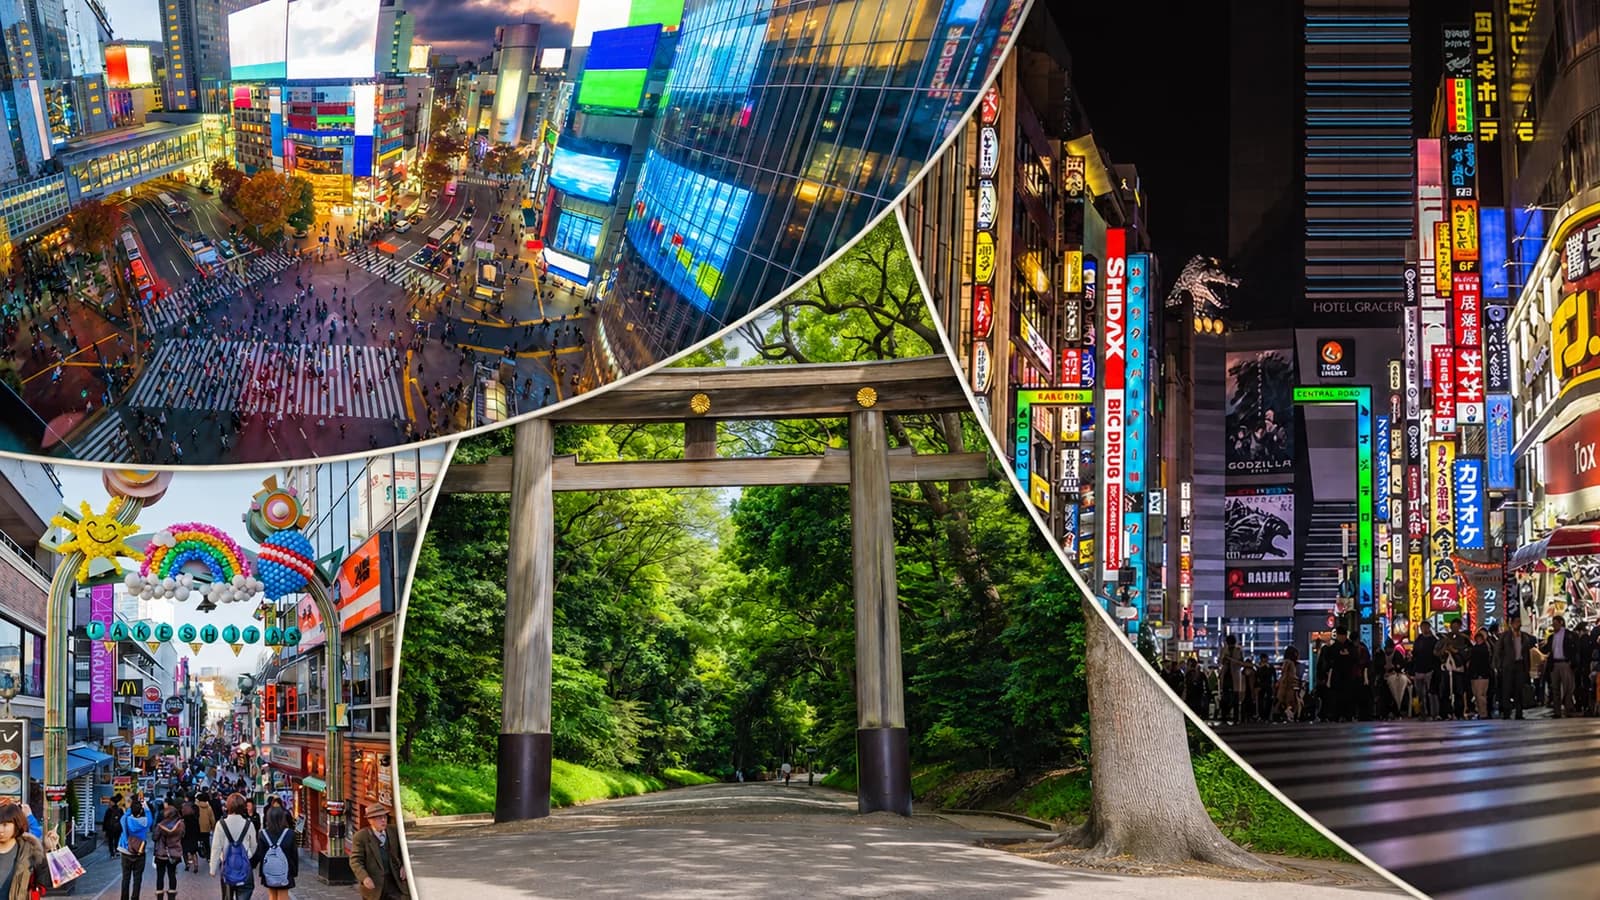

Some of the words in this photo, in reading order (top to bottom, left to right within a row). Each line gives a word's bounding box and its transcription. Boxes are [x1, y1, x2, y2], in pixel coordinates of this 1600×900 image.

[1459, 262, 1474, 271] 6F
[1106, 257, 1125, 360] SHIDAX
[1313, 302, 1352, 313] HOTEL
[1354, 302, 1404, 313] GRACER
[1297, 390, 1334, 398] CENTRAL
[1107, 399, 1121, 427] BIC
[1107, 431, 1121, 479] DRUG
[1228, 460, 1292, 470] GODZILLA
[1458, 464, 1480, 544] カラオケ
